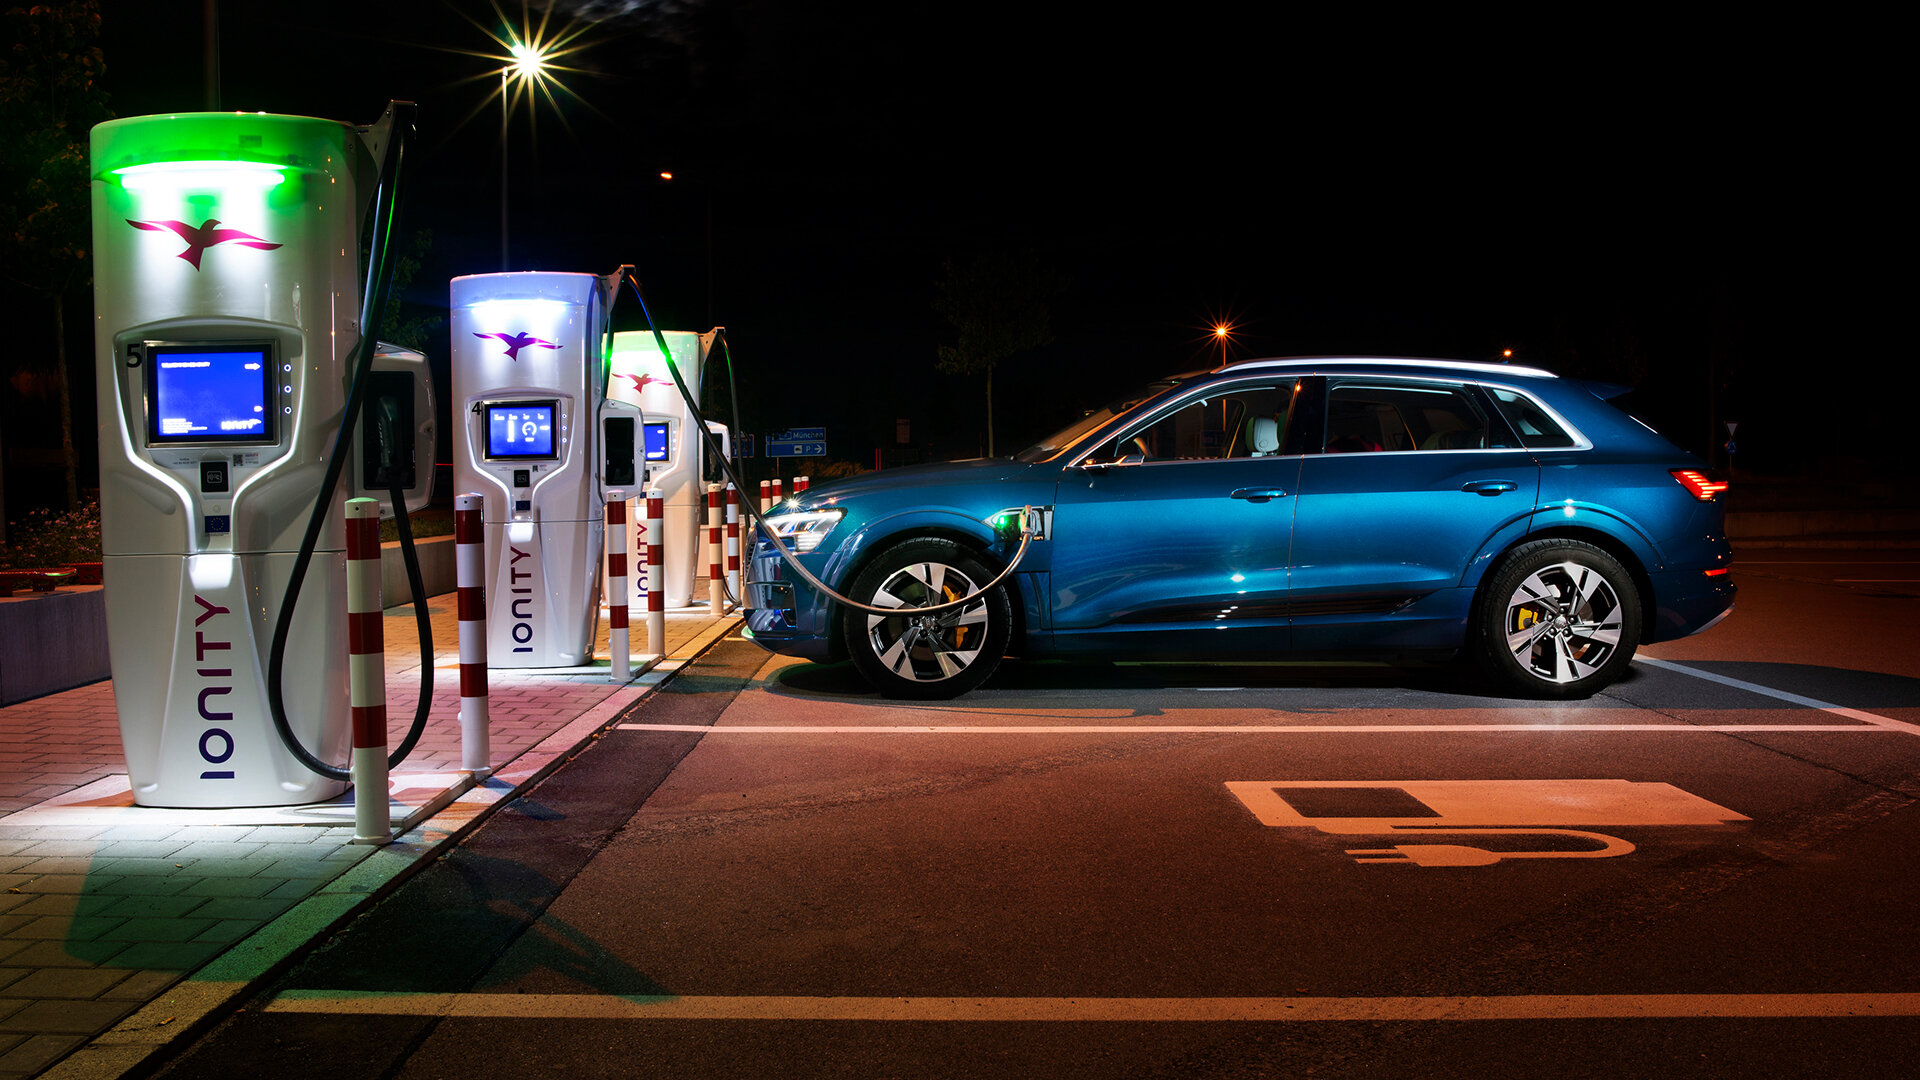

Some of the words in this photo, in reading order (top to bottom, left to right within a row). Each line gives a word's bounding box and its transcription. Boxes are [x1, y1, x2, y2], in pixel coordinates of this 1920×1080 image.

[126, 343, 142, 368] 5
[471, 401, 482, 415] 4
[637, 523, 648, 597] IONITY
[510, 546, 533, 653] IONITY
[194, 594, 235, 779] IONITY
